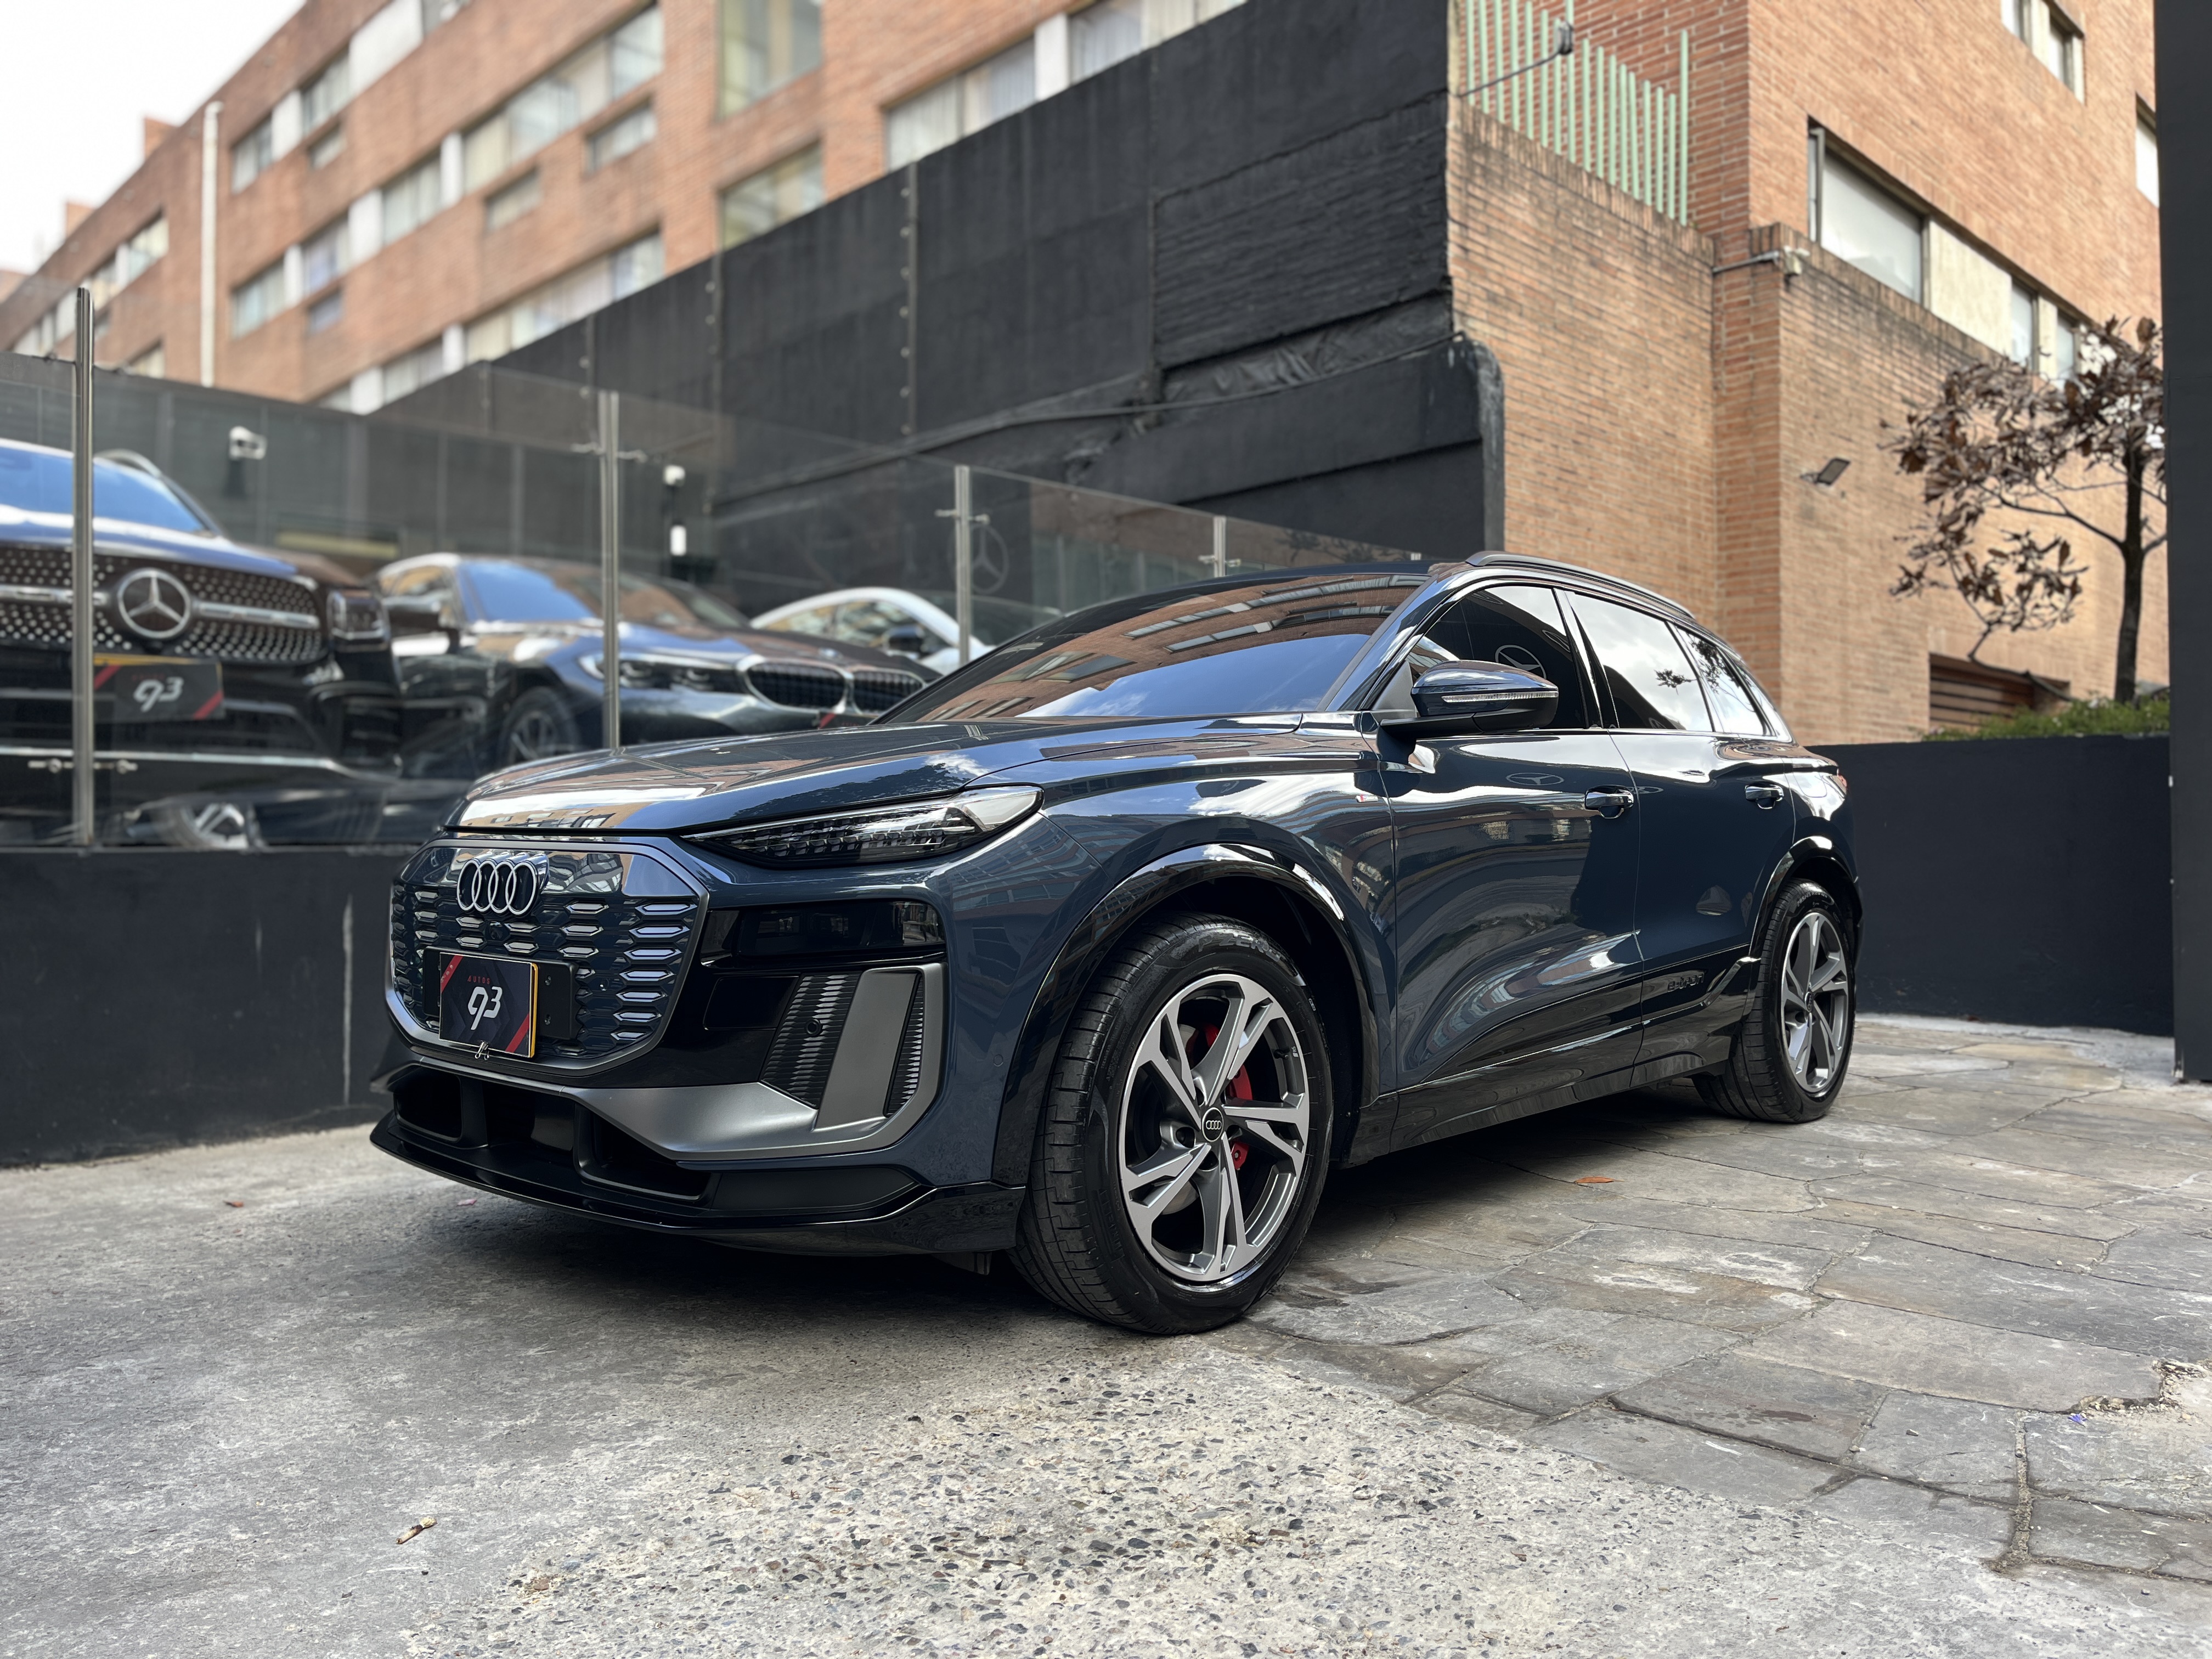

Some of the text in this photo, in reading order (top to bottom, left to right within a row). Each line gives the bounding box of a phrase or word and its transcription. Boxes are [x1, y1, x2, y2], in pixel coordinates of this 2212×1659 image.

[133, 676, 184, 712] 93
[467, 975, 490, 985] AUTOS
[1668, 973, 1704, 992] e-tron
[467, 986, 503, 1030] 93
